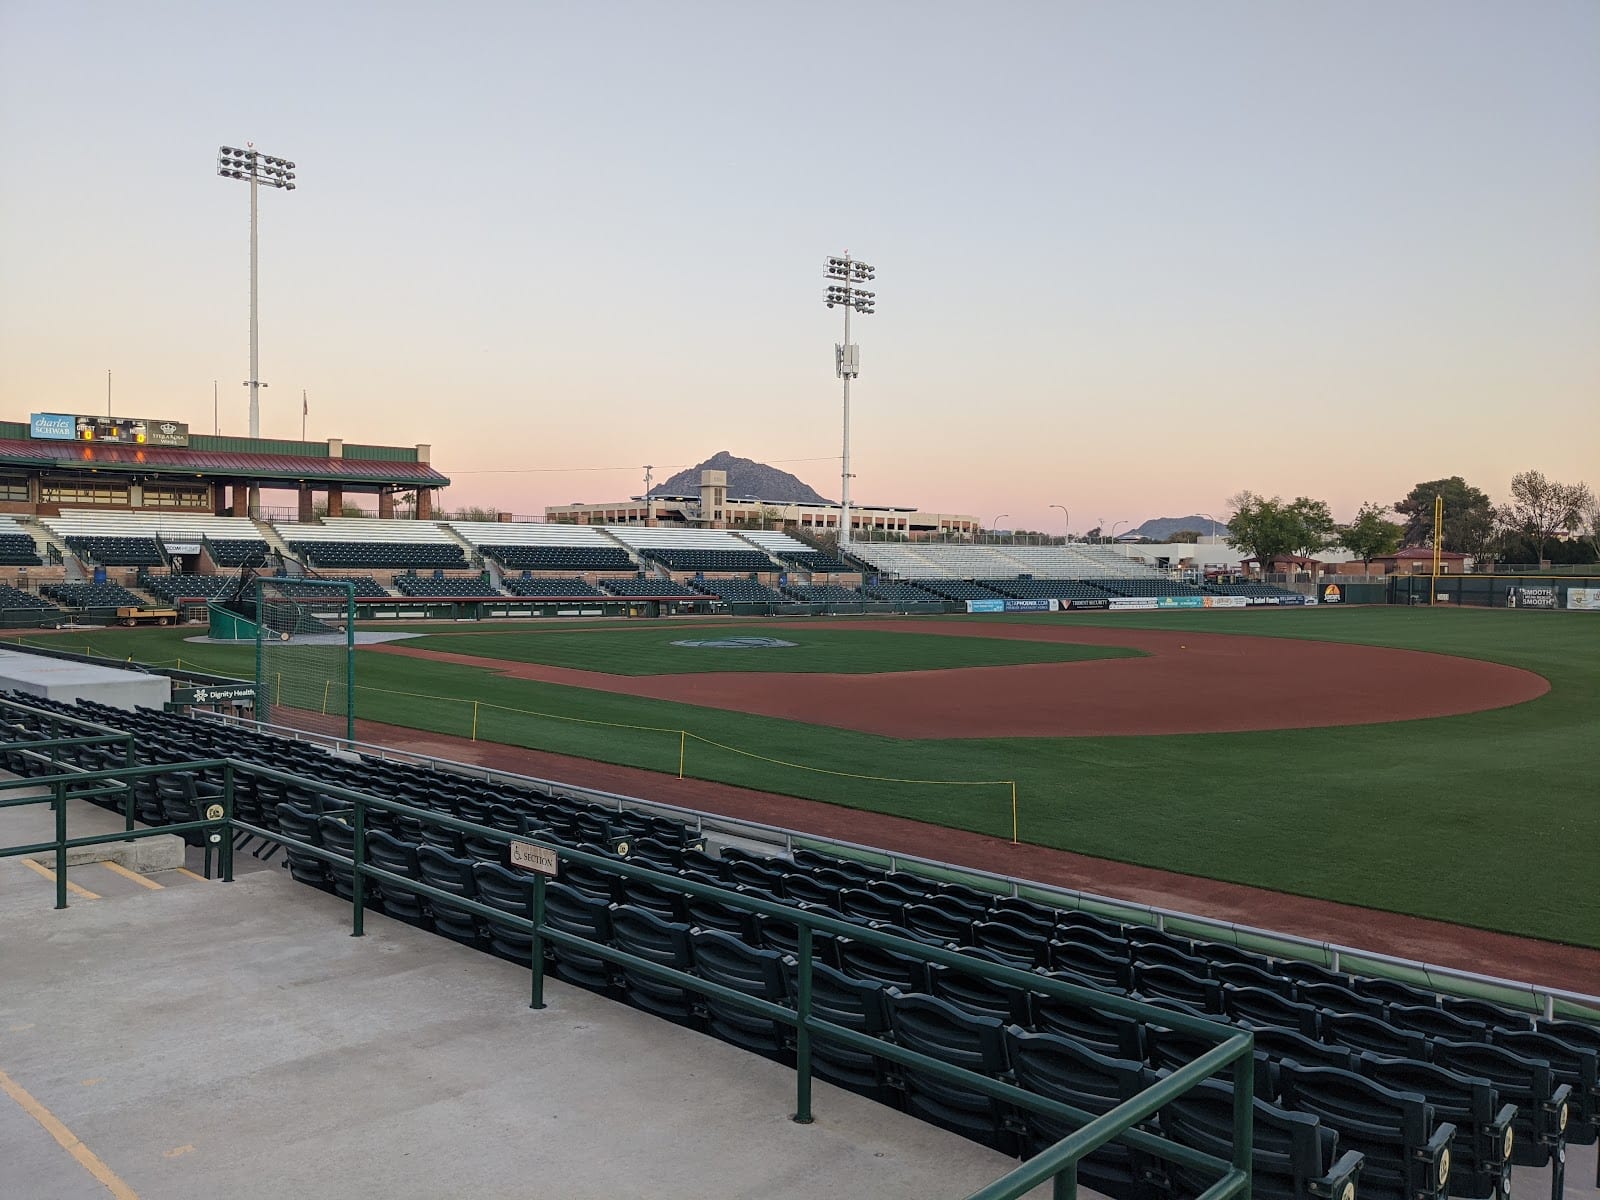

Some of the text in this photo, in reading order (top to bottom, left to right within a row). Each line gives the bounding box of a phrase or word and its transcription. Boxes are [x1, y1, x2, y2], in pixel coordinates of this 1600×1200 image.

[35, 418, 69, 428] charles
[35, 427, 70, 435] SCHWAB
[210, 690, 233, 699] Dignity
[523, 852, 553, 867] SECTION
